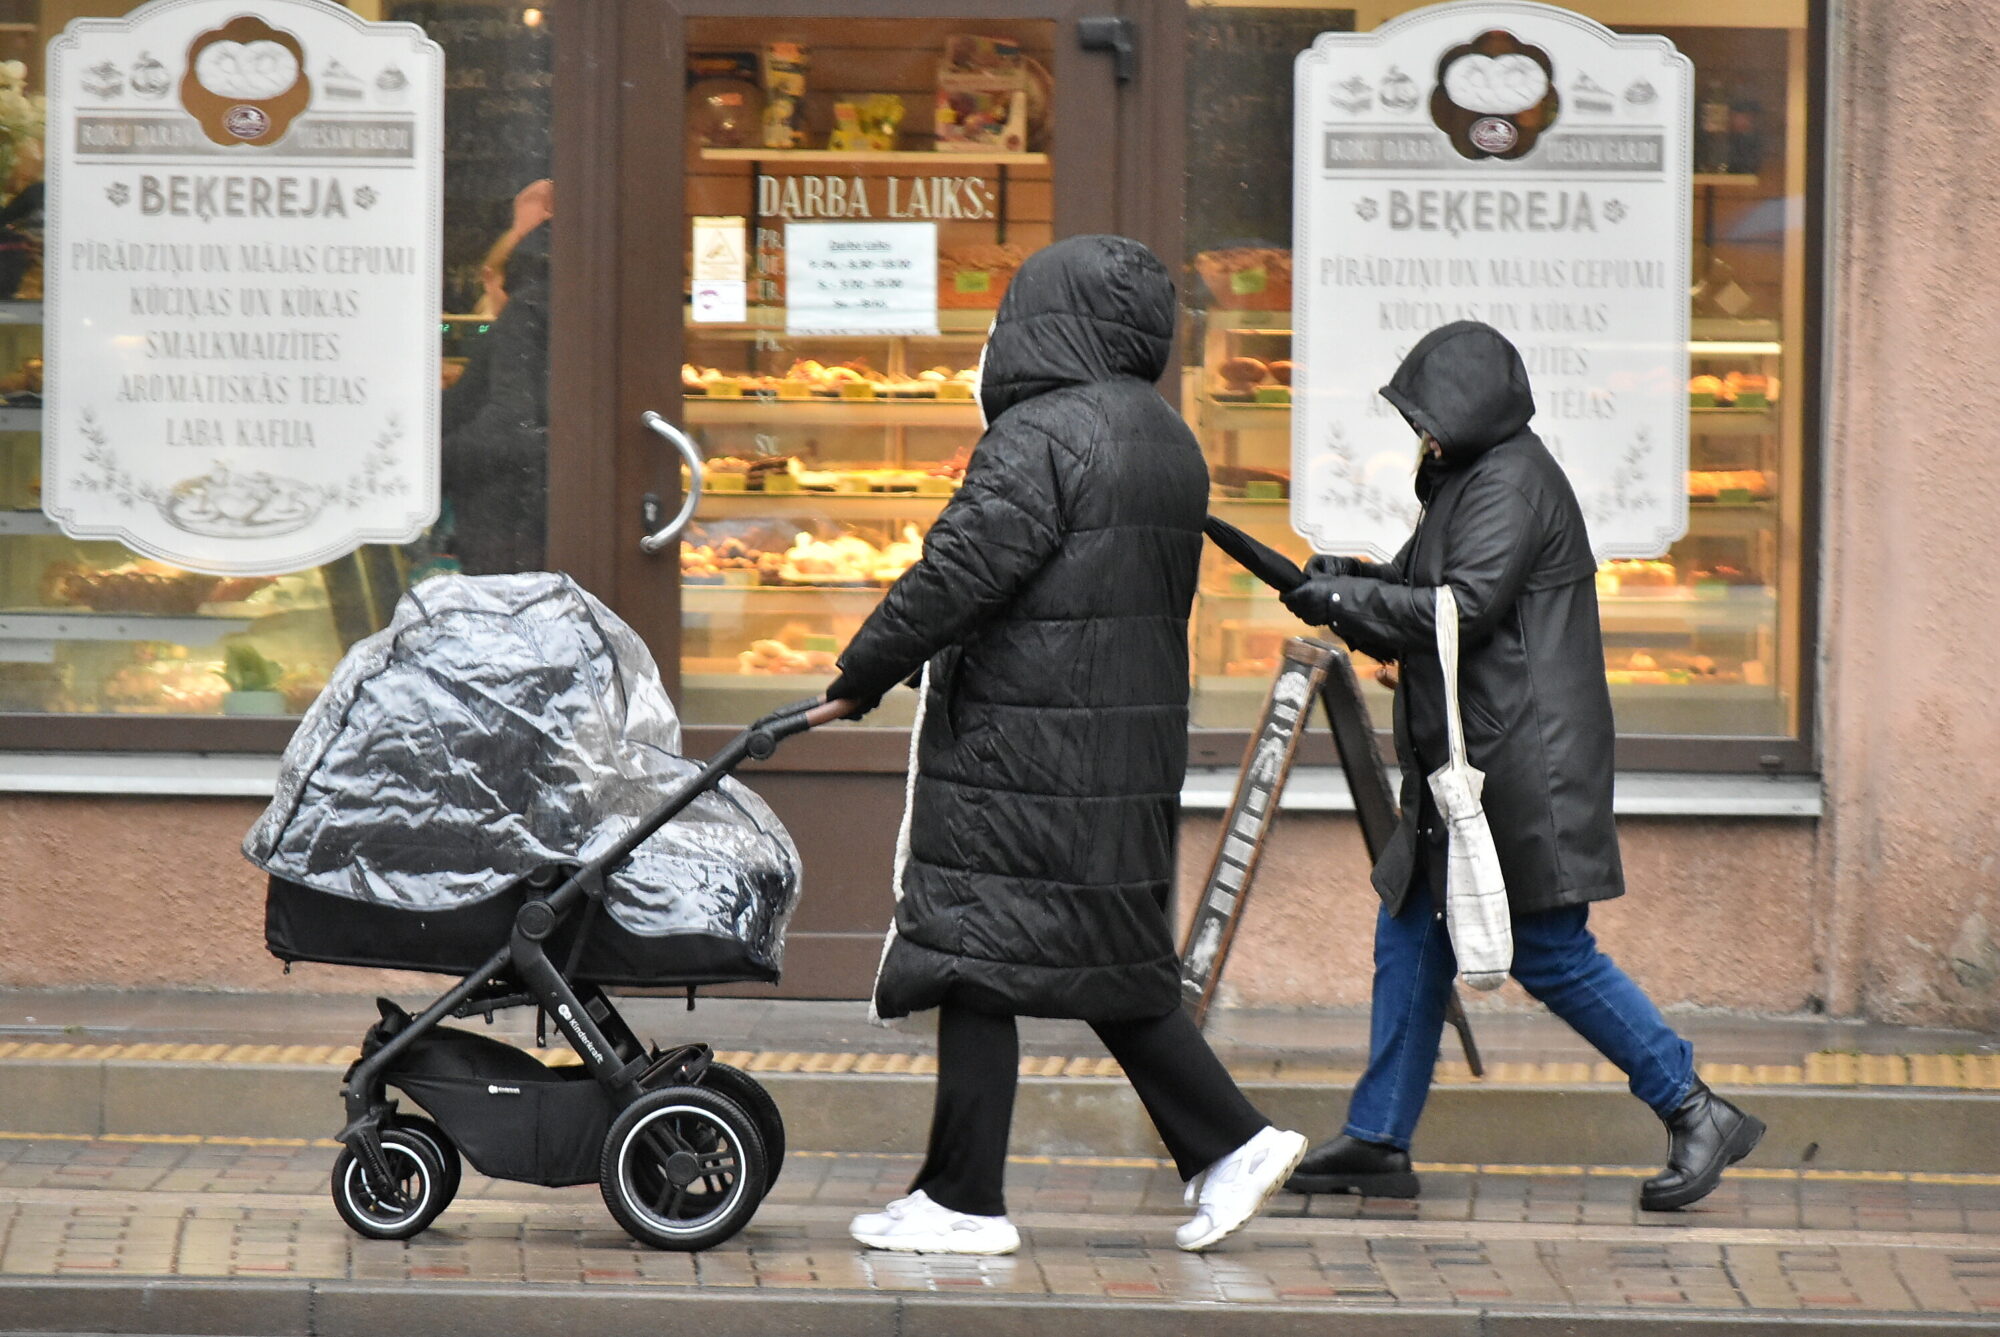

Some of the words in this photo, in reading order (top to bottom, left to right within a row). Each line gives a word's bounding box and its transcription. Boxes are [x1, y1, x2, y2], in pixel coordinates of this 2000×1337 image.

[139, 174, 349, 223] BEĶEREJA
[758, 175, 870, 218] DARBA
[887, 176, 996, 219] LAIKS:
[1388, 189, 1598, 238] BEĶEREJA
[71, 240, 194, 277] PĪRĀDZIŅI
[198, 244, 231, 273] UN
[237, 241, 319, 274] MĀJAS
[323, 245, 416, 275] CEPUMI
[1319, 254, 1442, 292] PĪRĀDZIŅI
[1447, 257, 1479, 288] UN
[1486, 255, 1567, 289] MĀJAS
[1571, 258, 1665, 289] CEPUMI
[130, 283, 234, 320] KŪCIŅAS
[239, 288, 272, 318] UN
[280, 285, 361, 318] KŪKAS
[1489, 303, 1521, 331] UN
[1530, 300, 1610, 333] KŪKAS
[145, 329, 342, 361] SMALKMAIZĪTES
[116, 371, 292, 405] AROMĀTISKĀS
[300, 371, 369, 406] TĒJAS
[1549, 388, 1618, 419] TĒJAS
[165, 418, 224, 448] LABA
[235, 418, 317, 448] KAFIJA
[568, 1018, 604, 1065] Kinderkraft
